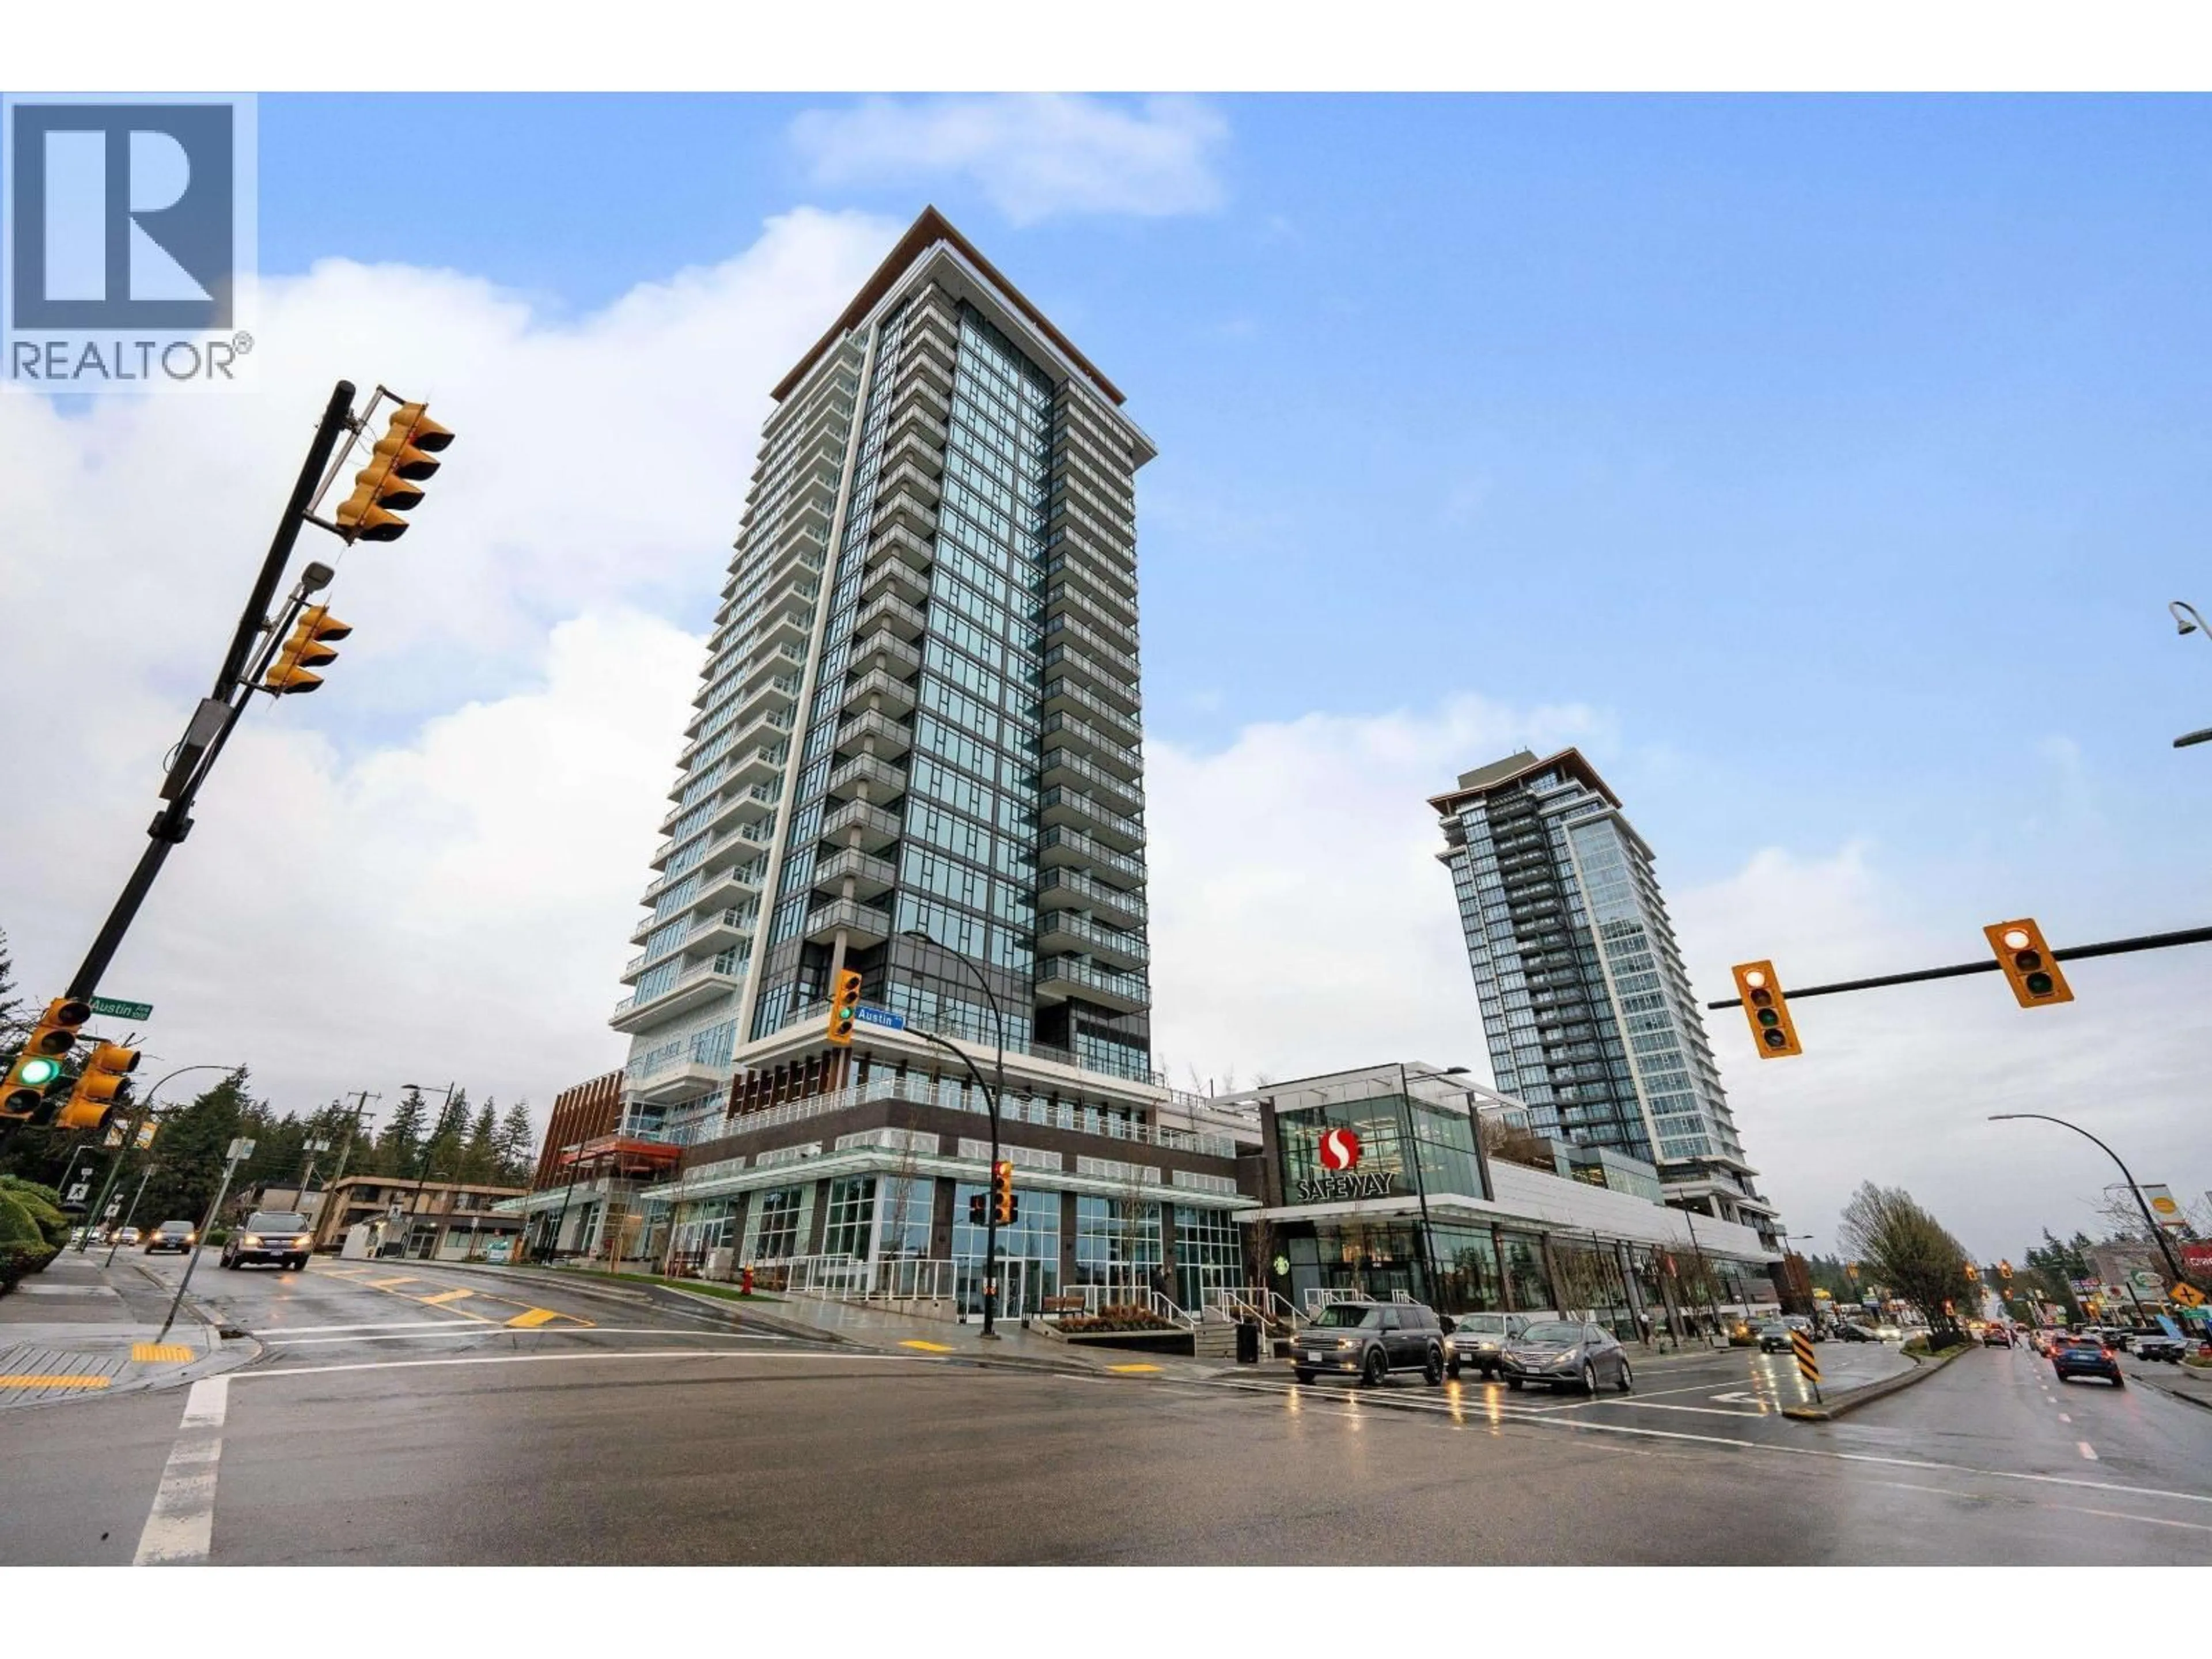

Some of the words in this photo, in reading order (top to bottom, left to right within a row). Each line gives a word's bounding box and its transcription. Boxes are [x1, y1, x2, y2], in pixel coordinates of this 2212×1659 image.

[91, 999, 132, 1016] Austin
[858, 1009, 891, 1026] Austin
[1298, 1171, 1393, 1202] SAFEWAY
